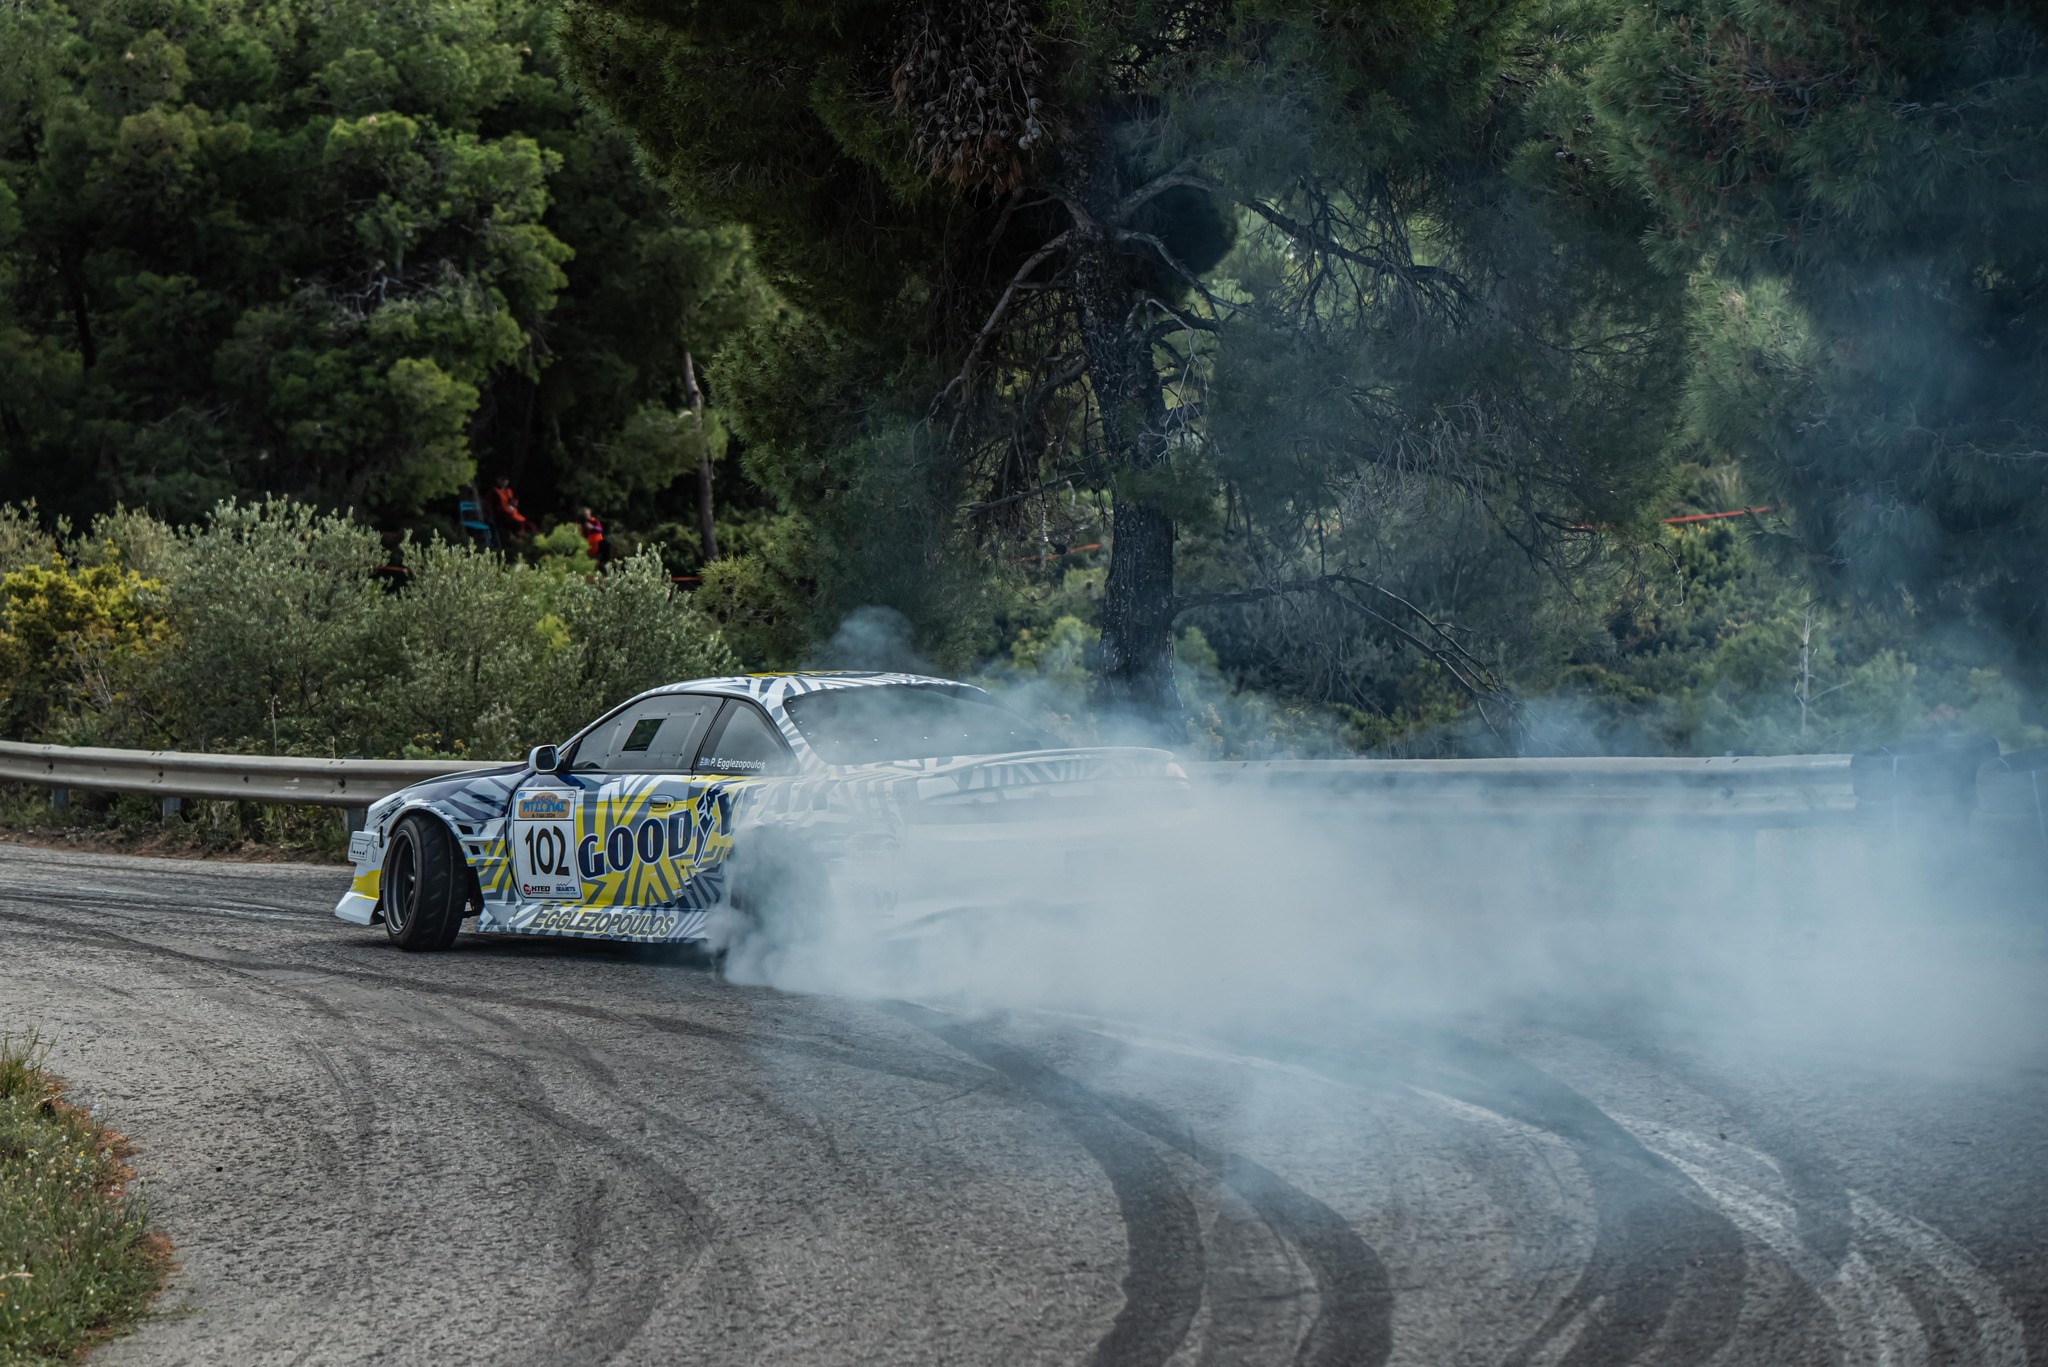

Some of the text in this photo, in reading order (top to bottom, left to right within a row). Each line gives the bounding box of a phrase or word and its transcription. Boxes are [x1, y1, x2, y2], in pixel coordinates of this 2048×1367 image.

[709, 757, 766, 770] P. Egglezopoulos
[525, 825, 570, 877] 102
[528, 904, 676, 937] EGGLEZOPOULOS
